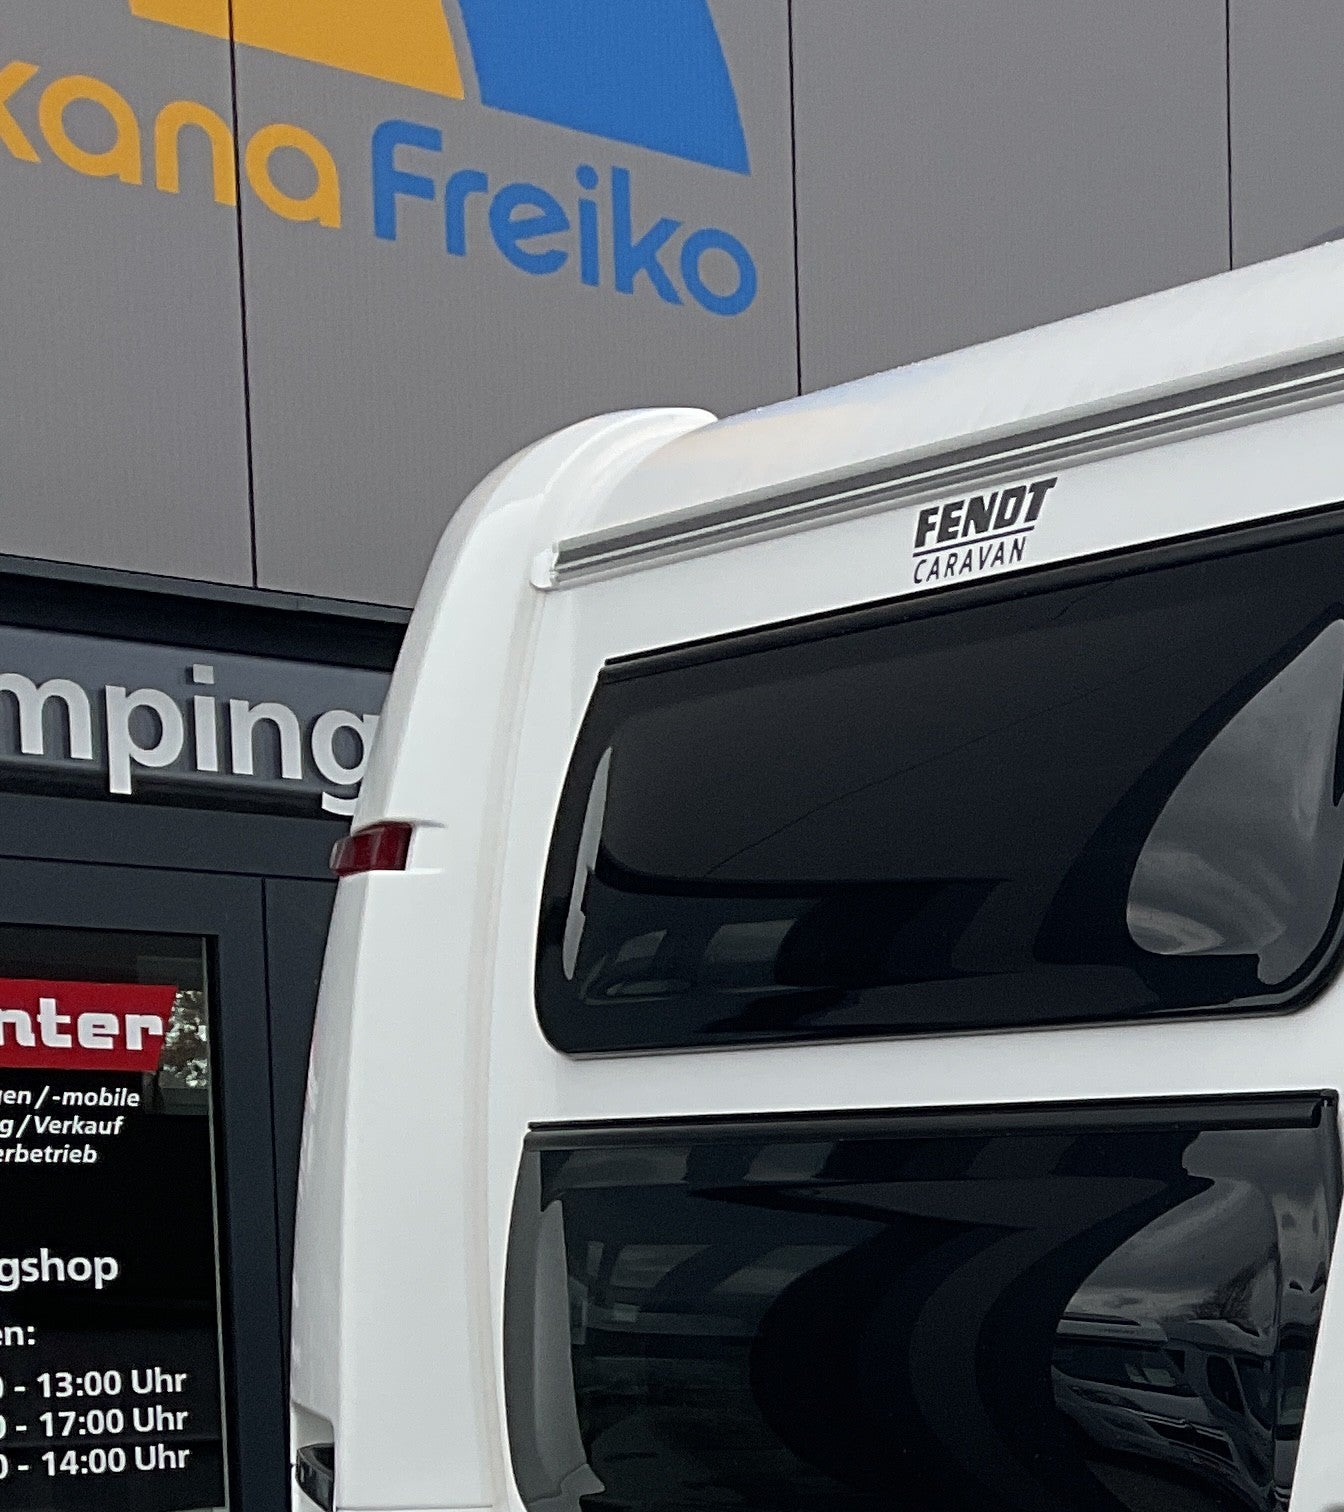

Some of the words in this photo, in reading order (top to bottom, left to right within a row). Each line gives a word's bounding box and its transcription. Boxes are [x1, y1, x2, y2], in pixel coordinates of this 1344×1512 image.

[371, 119, 757, 317] Freiko
[914, 477, 1058, 548] FENDT
[913, 536, 1026, 584] CARAVAN
[0, 664, 381, 816] mping
[0, 997, 163, 1050] nter
[0, 1089, 32, 1106] en
[34, 1115, 124, 1135] Verkauf
[0, 1248, 119, 1291] gshop
[0, 1326, 36, 1346] n:
[37, 1370, 122, 1398] 13:00
[131, 1367, 187, 1395] Uhr
[39, 1409, 124, 1437] 17:00
[132, 1405, 188, 1432] Uhr
[41, 1448, 126, 1476] 14:00
[134, 1444, 191, 1471] Uhr
